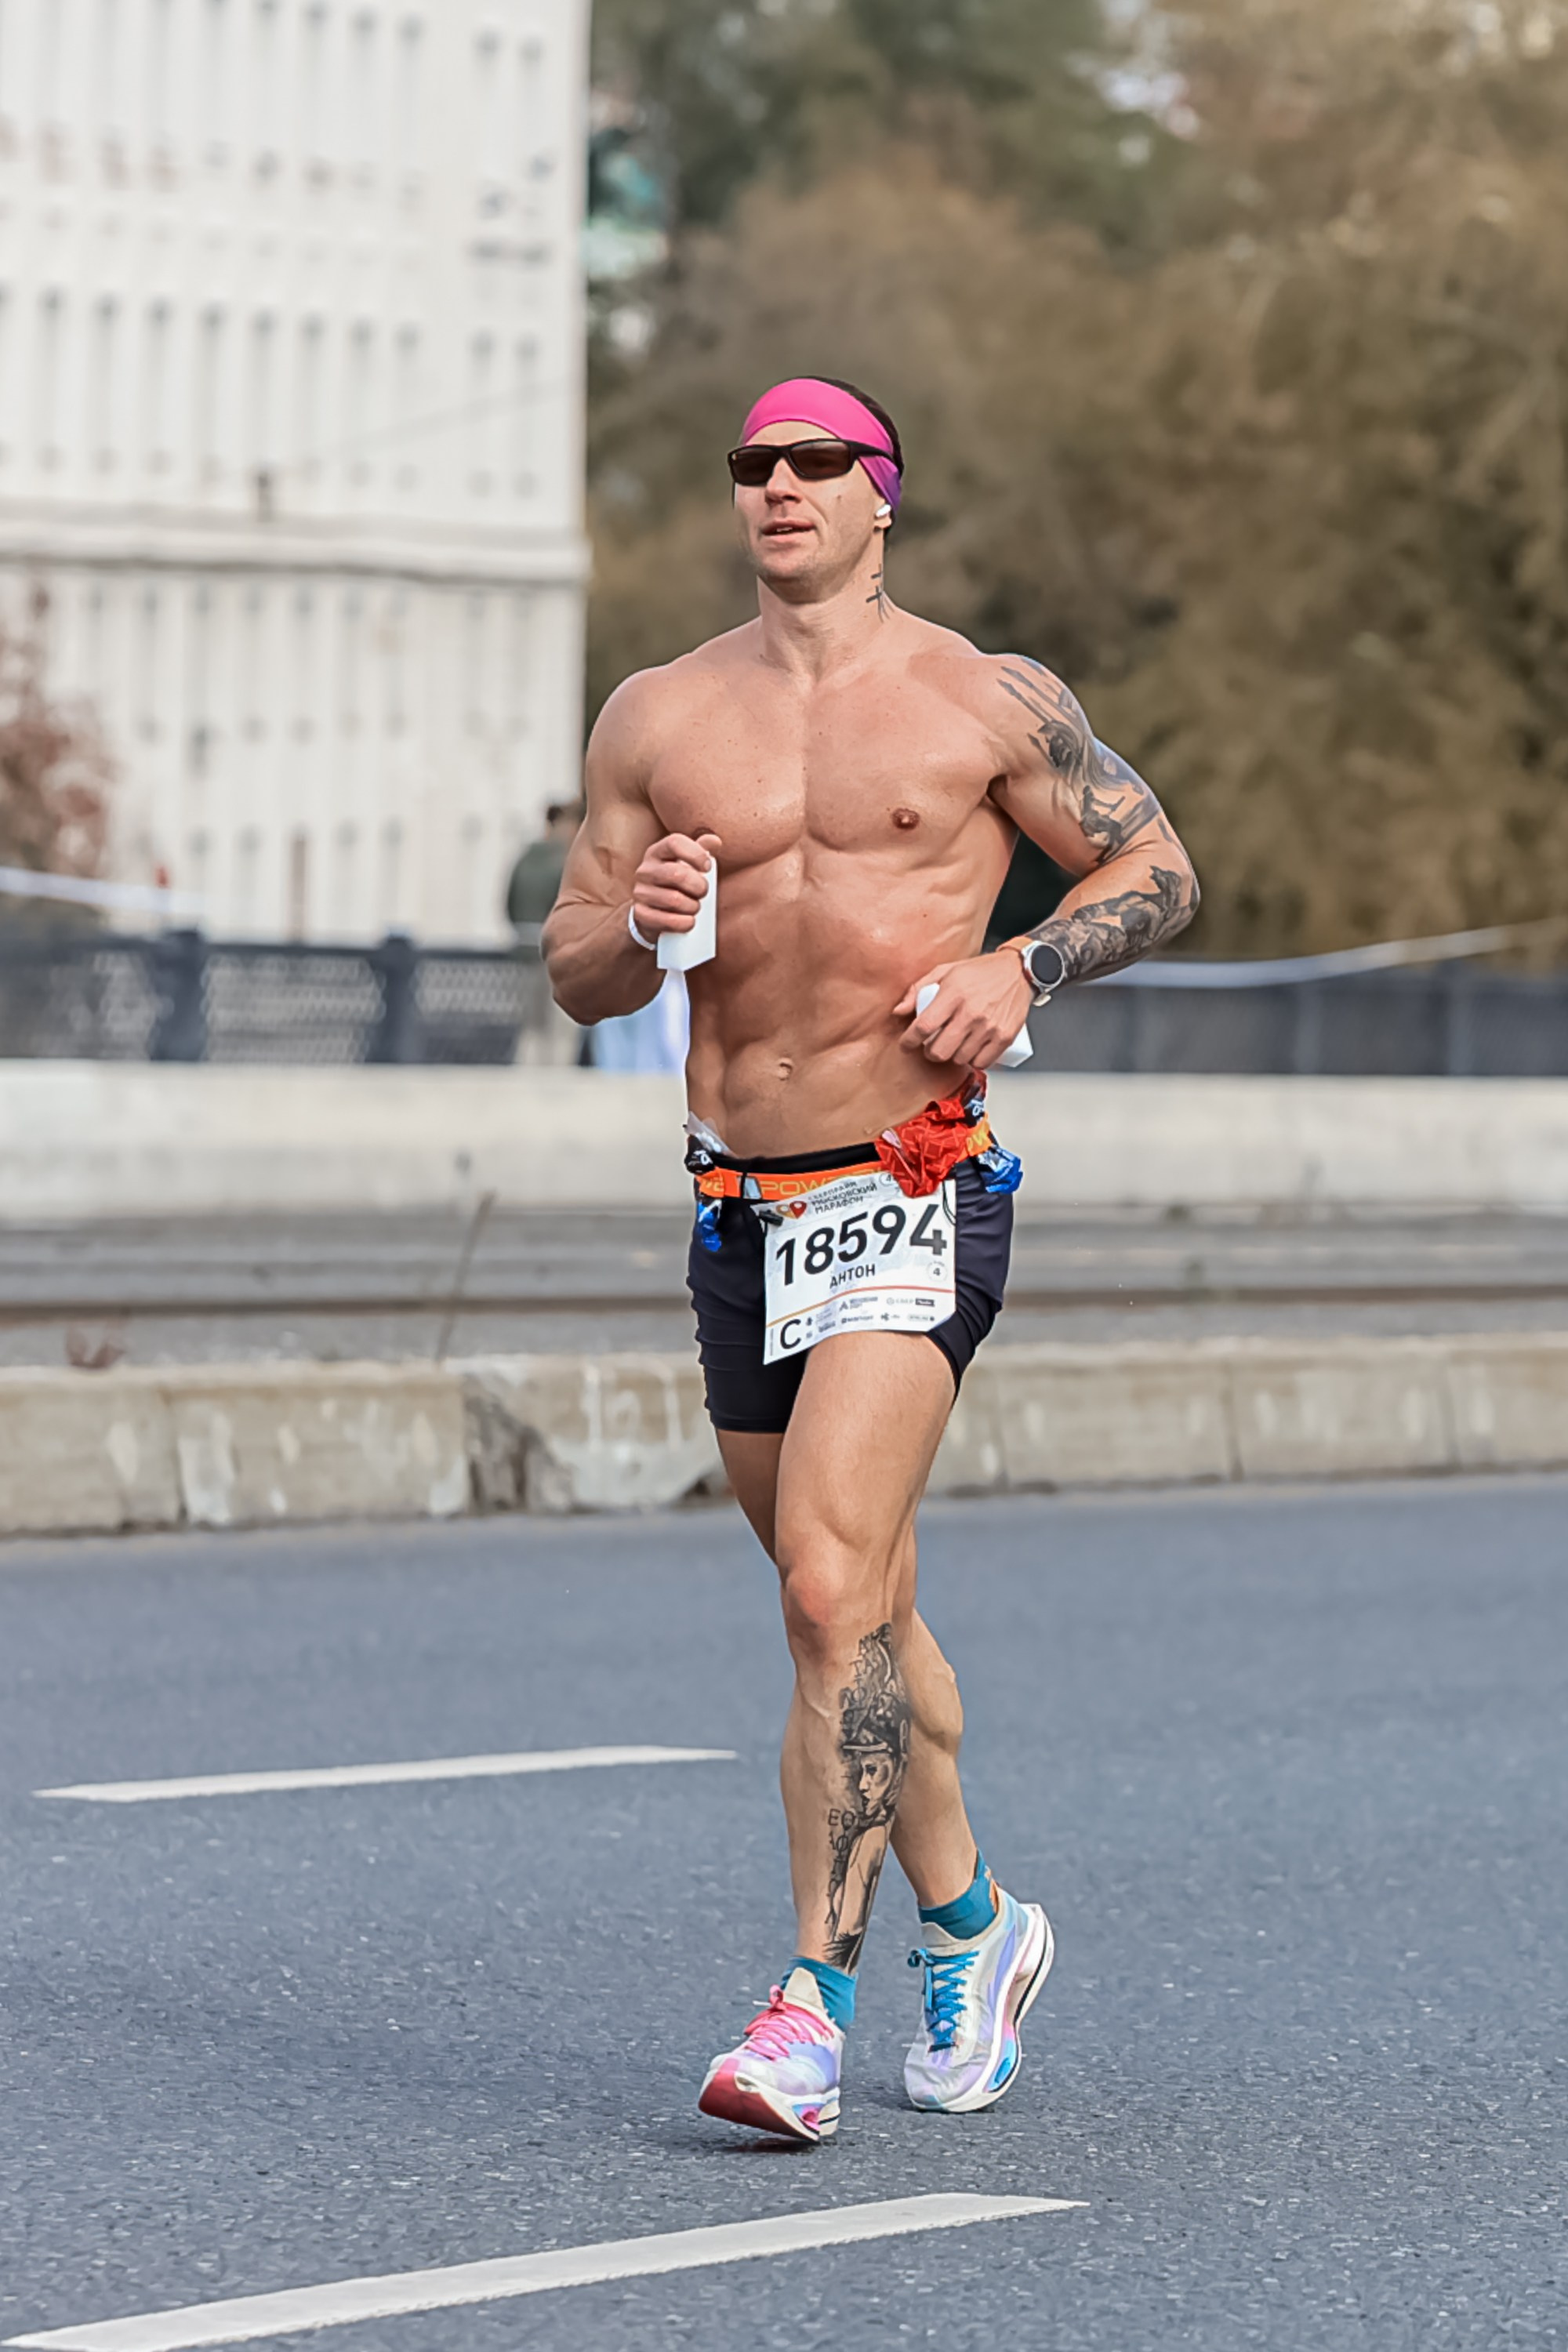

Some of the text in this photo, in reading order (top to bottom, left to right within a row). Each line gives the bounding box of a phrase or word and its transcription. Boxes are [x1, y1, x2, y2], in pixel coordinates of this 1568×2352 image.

[815, 1196, 863, 1214] МАРАФОН
[775, 1204, 947, 1286] 18594
[829, 1264, 876, 1289] АНТОН
[933, 1268, 941, 1276] 4
